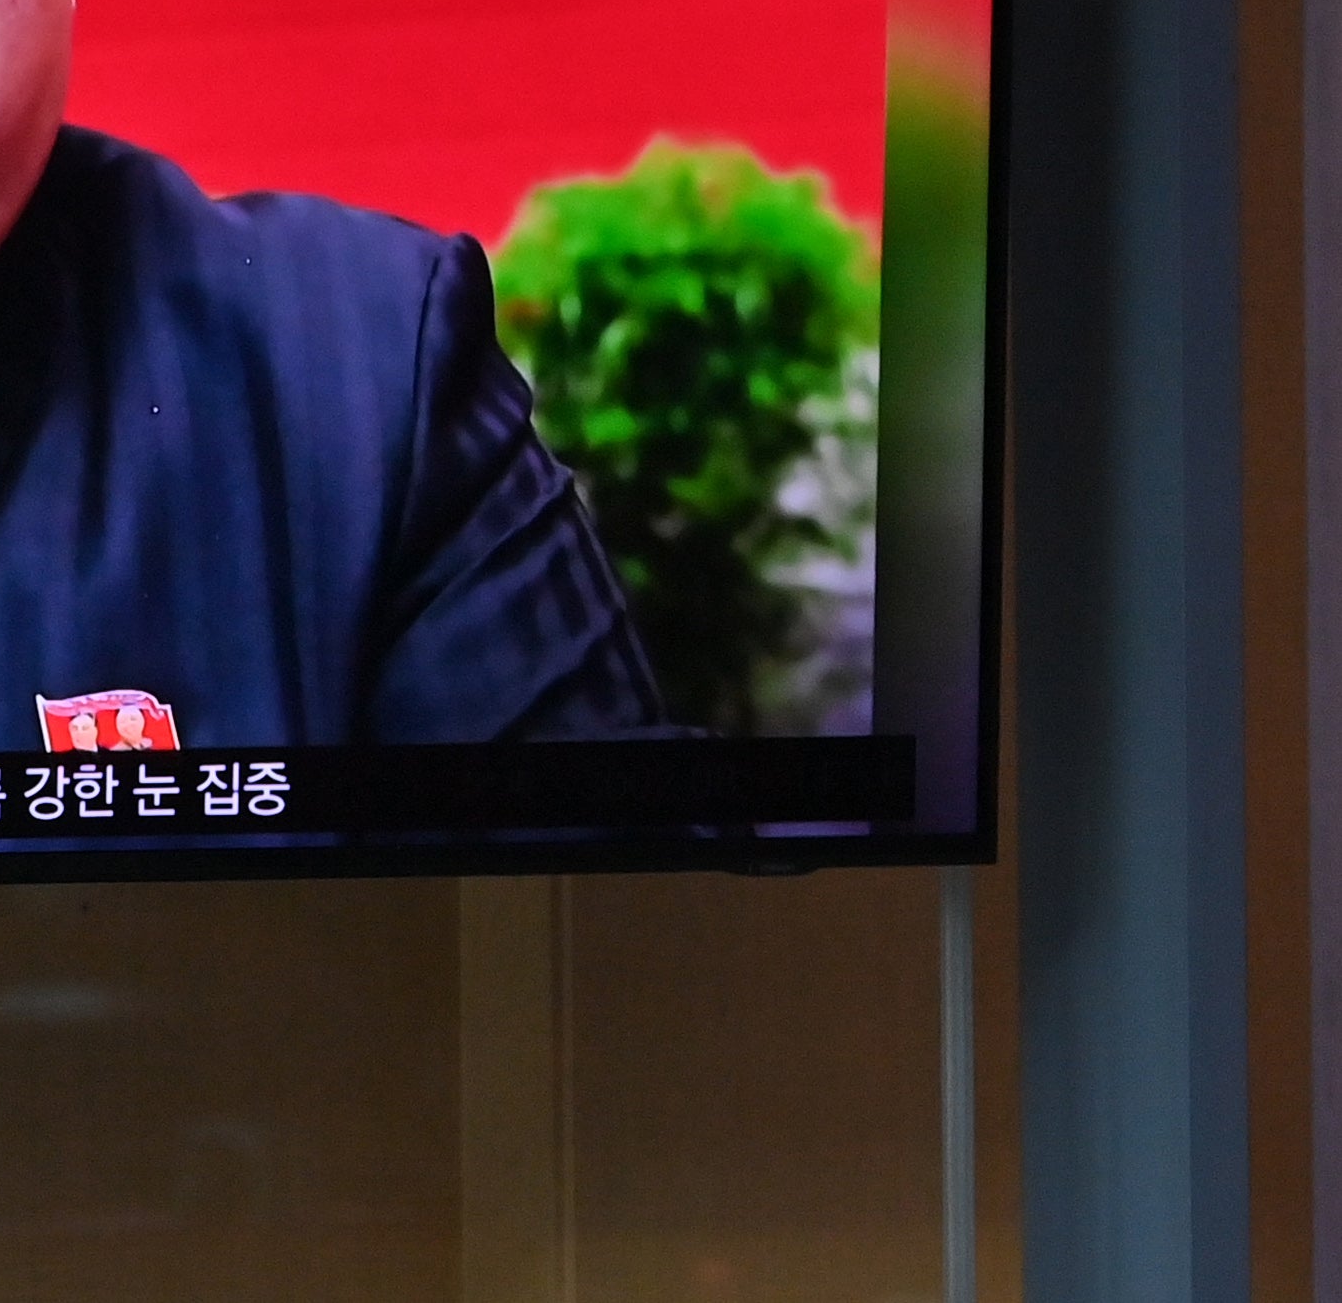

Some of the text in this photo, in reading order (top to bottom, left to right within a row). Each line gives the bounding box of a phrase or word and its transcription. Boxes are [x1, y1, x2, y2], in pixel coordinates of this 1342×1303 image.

[23, 764, 120, 820] 강한
[132, 764, 181, 817] 눈
[196, 762, 292, 817] 집중
